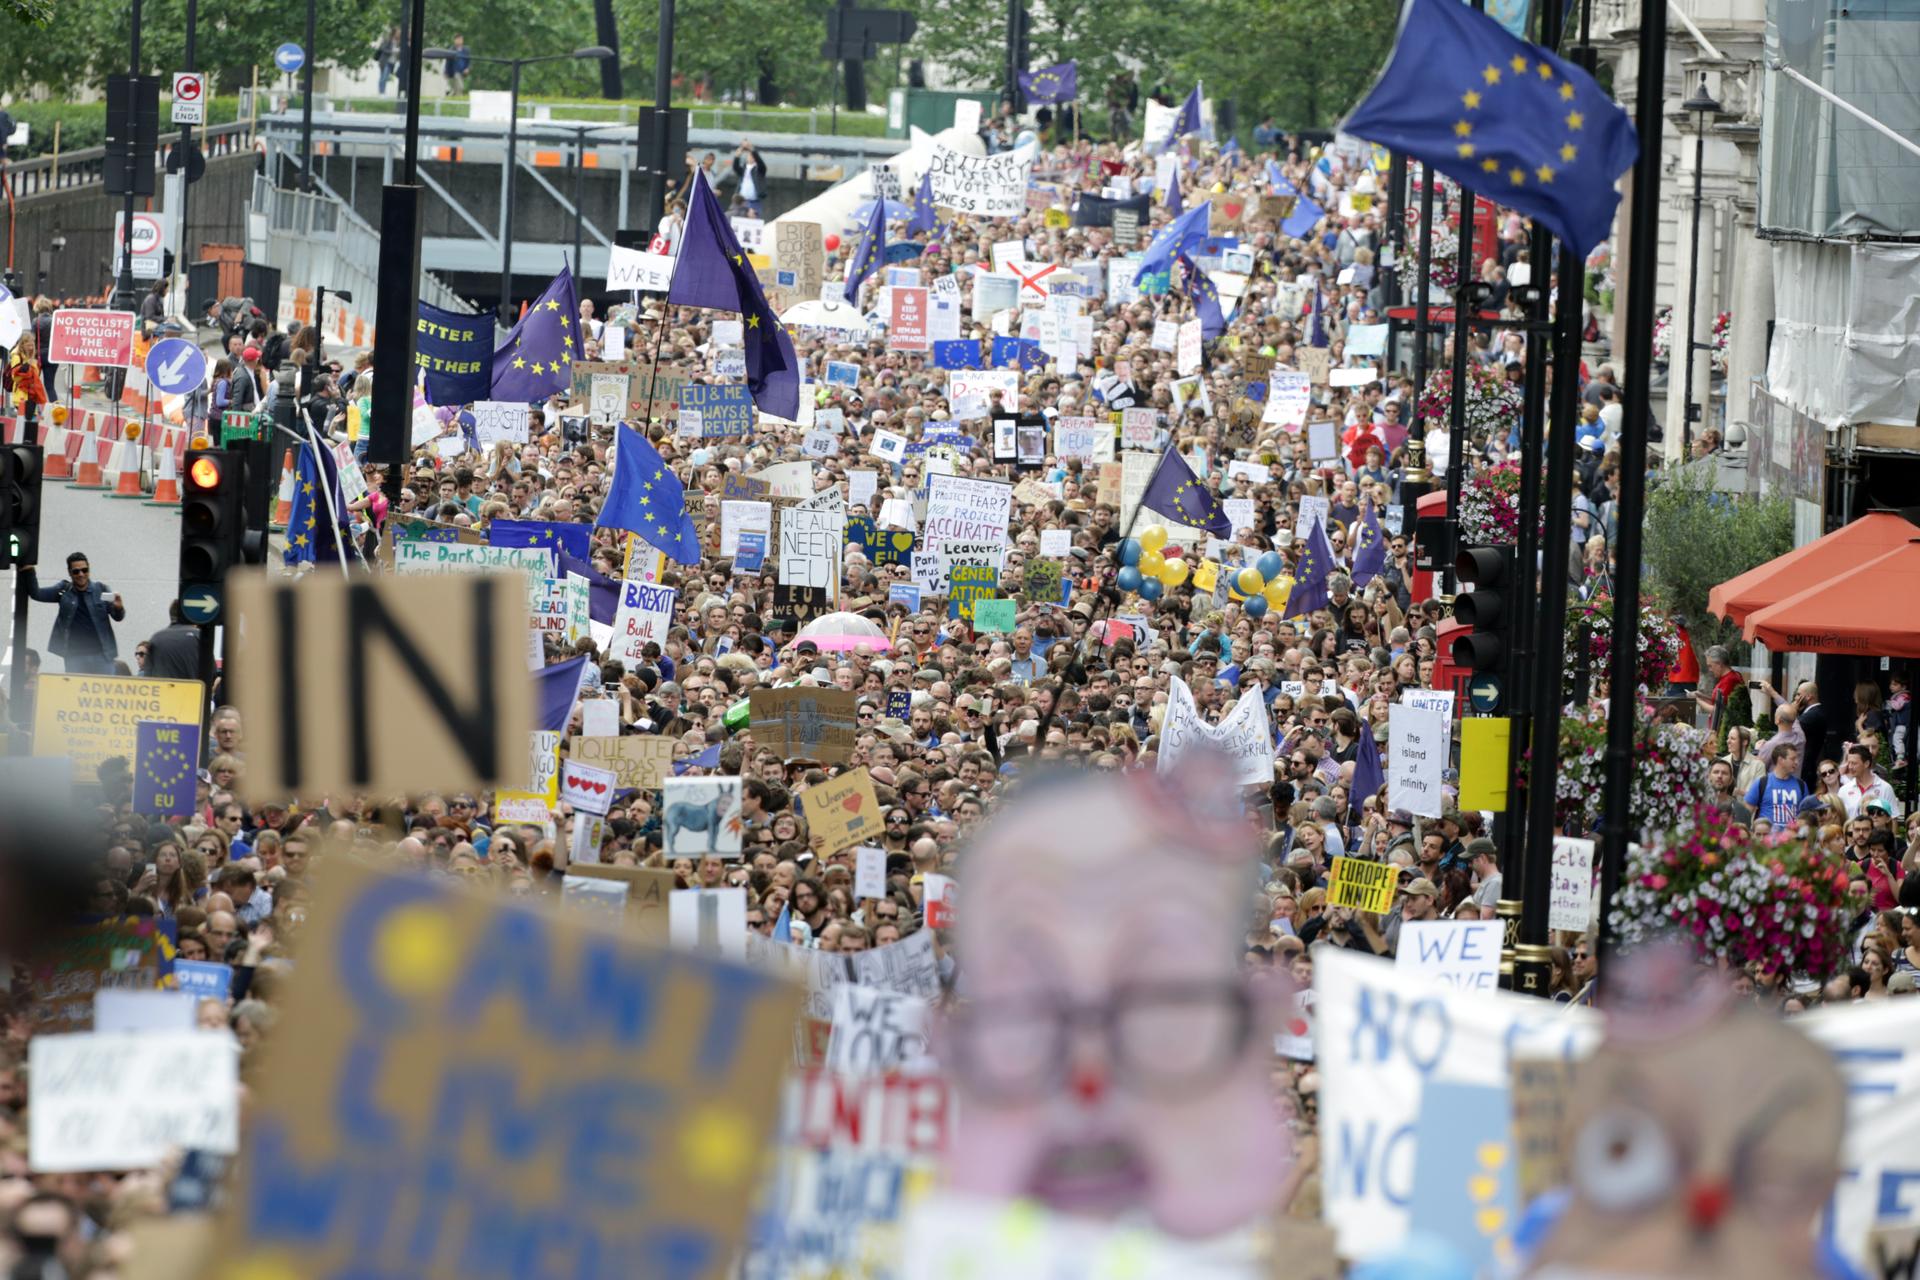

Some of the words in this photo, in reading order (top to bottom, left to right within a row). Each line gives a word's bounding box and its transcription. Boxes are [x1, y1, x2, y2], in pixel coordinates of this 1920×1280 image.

[175, 112, 200, 121] ENDS
[786, 225, 813, 240] BIG
[56, 317, 73, 326] NO
[75, 317, 131, 328] CYCLISTS
[900, 313, 919, 321] CALM
[64, 326, 122, 338] THROUGH
[80, 337, 103, 348] THE
[64, 346, 118, 359] TUNNELS
[682, 386, 706, 406] EU
[710, 386, 721, 401] &
[724, 386, 744, 400] ME
[740, 404, 749, 419] &
[929, 450, 951, 461] WE
[685, 499, 705, 514] BACK
[935, 490, 966, 502] PROJECT
[970, 494, 1007, 512] FEAR?
[784, 511, 804, 530] WE
[810, 514, 840, 531] ALL
[954, 508, 1003, 523] PROJECT
[926, 518, 1003, 541] ACCURATE
[783, 532, 839, 560] NEED
[865, 531, 887, 547] WE
[402, 543, 431, 561] The
[437, 546, 475, 564] Dark
[480, 547, 508, 567] Side
[951, 566, 995, 581] GENER
[625, 583, 675, 614] BREXIT
[789, 586, 813, 603] EU
[773, 605, 792, 616] WE
[529, 616, 567, 631] BLIND
[626, 617, 654, 639] Built
[1785, 634, 1819, 647] SMITH
[1834, 636, 1869, 649] WHISTLE
[79, 682, 161, 697] ADVANCE
[275, 582, 500, 790] IN
[1285, 684, 1302, 695] Say
[77, 697, 161, 712] WARNING
[1411, 699, 1450, 712] UNITED
[56, 710, 104, 723] ROAD
[156, 729, 180, 744] WE
[1407, 732, 1421, 744] the
[638, 738, 673, 759] TE
[1401, 746, 1426, 760] island
[603, 758, 655, 774] JODAS
[1408, 763, 1418, 774] of
[154, 794, 175, 808] EU
[1772, 788, 1798, 805] I'M
[1338, 859, 1390, 889] EUROPE
[1337, 883, 1382, 911] INNIT!
[1417, 926, 1488, 962] WE
[1350, 986, 1452, 1074] NO
